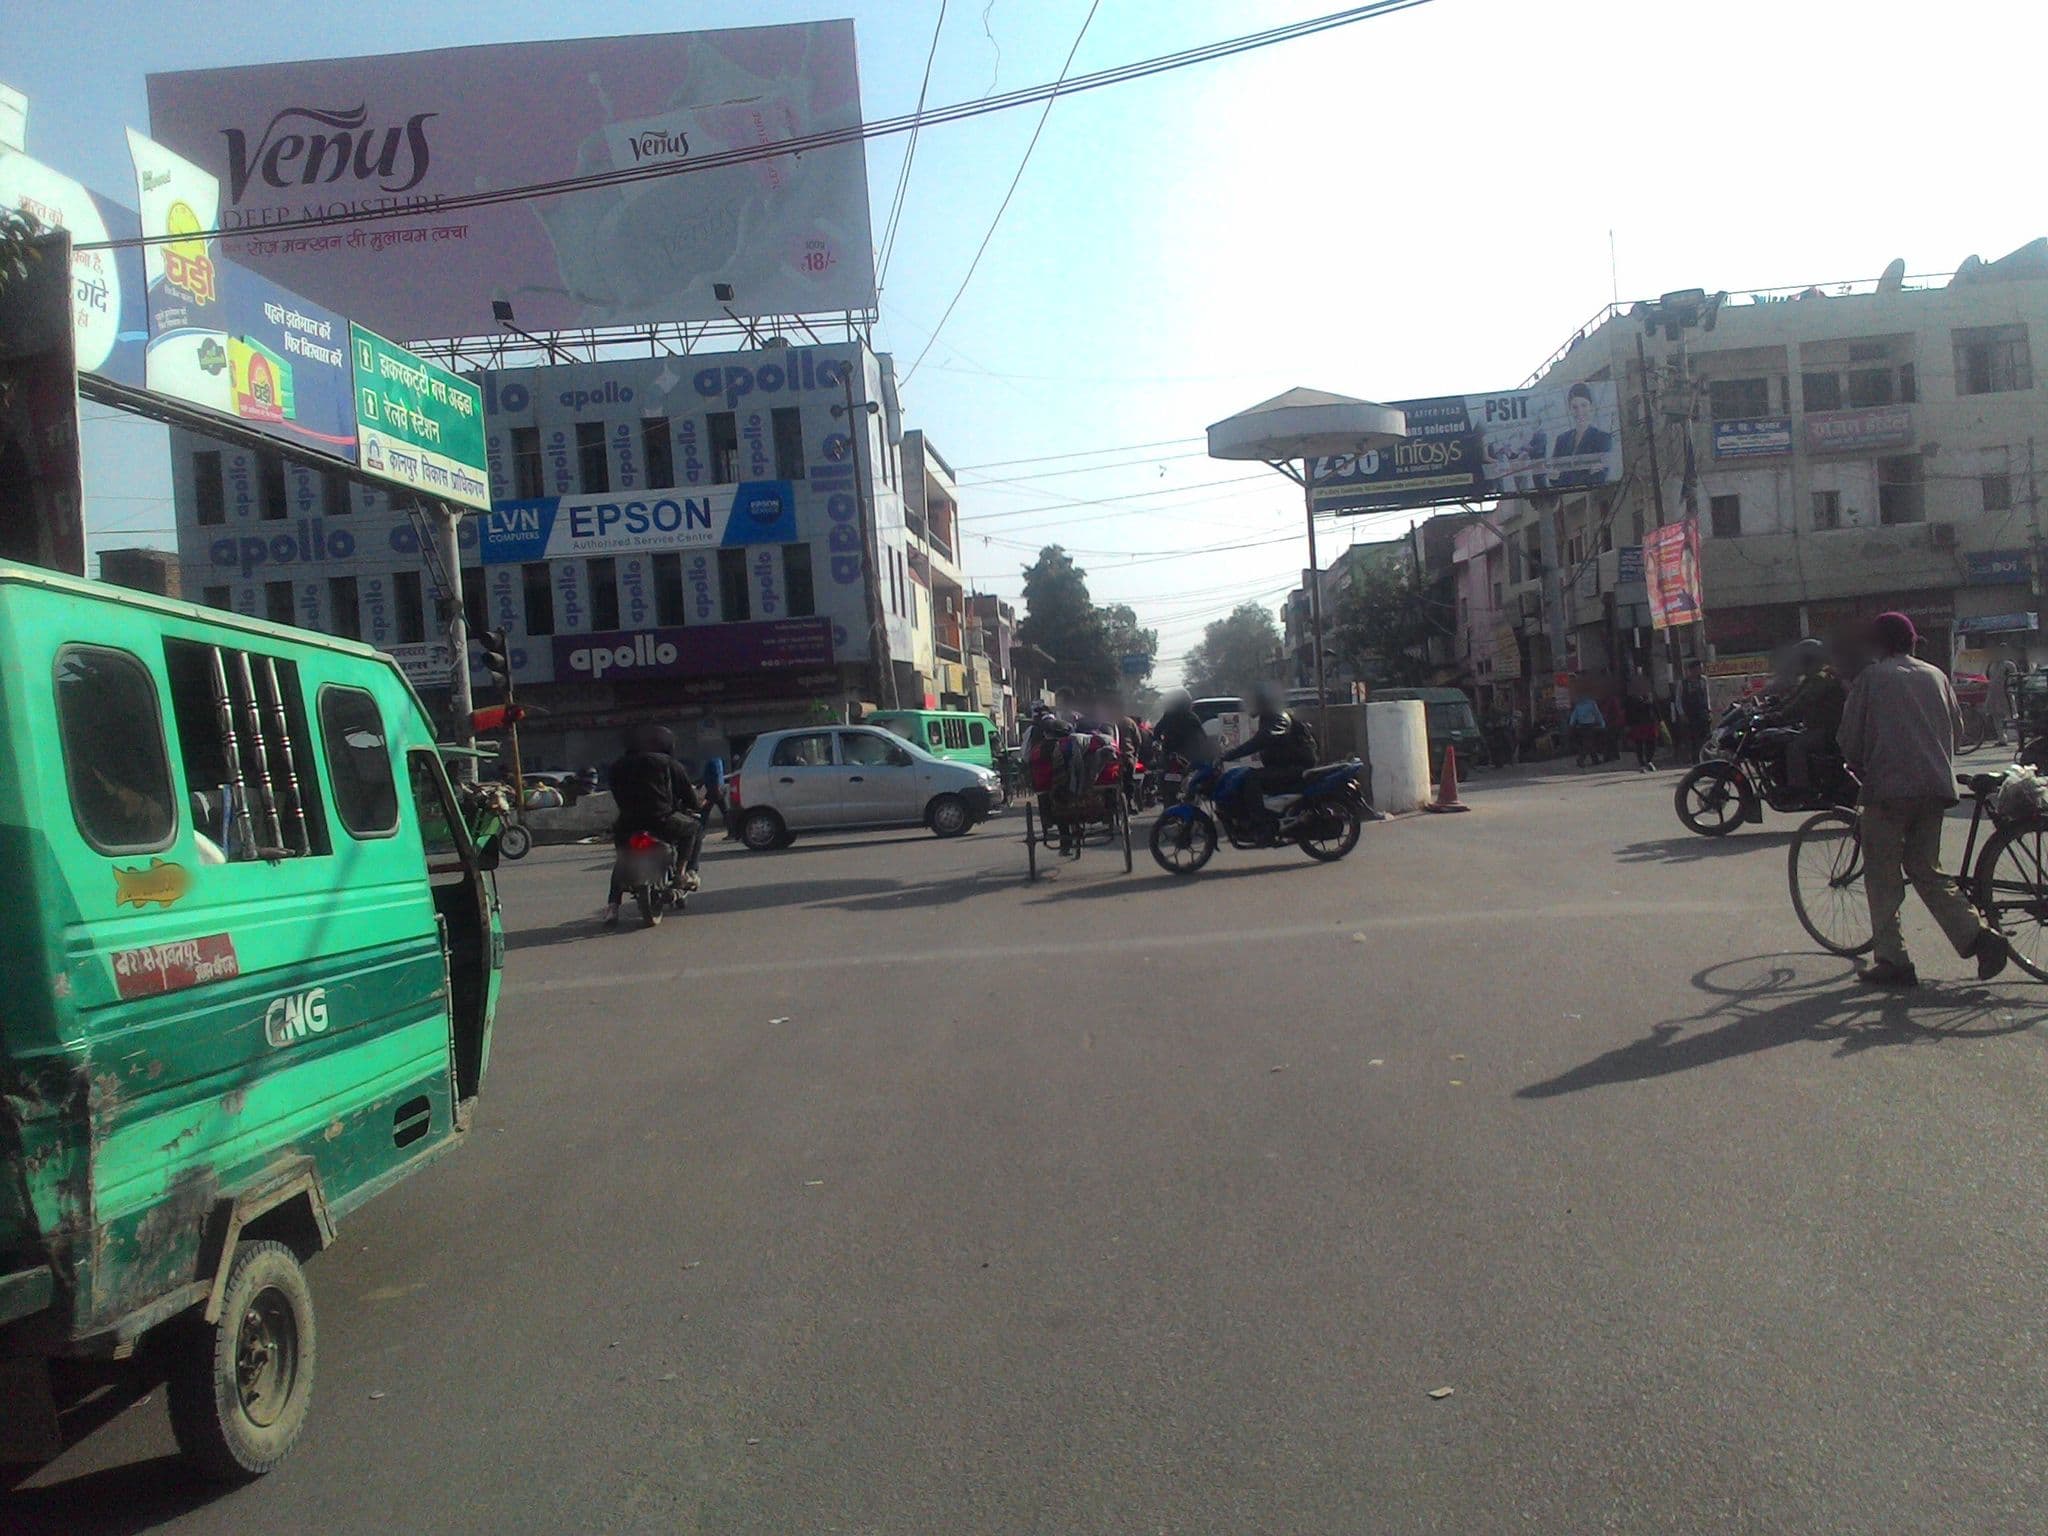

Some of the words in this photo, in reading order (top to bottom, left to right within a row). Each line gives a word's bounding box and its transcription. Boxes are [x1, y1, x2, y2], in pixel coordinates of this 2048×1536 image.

[218, 102, 439, 205] Venus
[629, 131, 689, 161] Venus
[223, 207, 290, 229] DEEP
[303, 193, 452, 223] MOISTURE
[263, 302, 285, 326] पहले
[284, 331, 300, 353] फिर
[430, 378, 446, 405] बस
[559, 381, 634, 412] apollo
[693, 349, 848, 410] apollo
[383, 392, 409, 430] रेलवे
[409, 406, 441, 444] स्टेशन
[1485, 396, 1529, 422] PSIT
[388, 449, 418, 483] कानपुर
[421, 454, 449, 488] विकास
[548, 432, 573, 493] apollo
[612, 424, 639, 487] apollo
[678, 420, 703, 482] apollo
[744, 415, 769, 476] apollo
[291, 466, 316, 512] apol
[487, 508, 540, 533] LVN
[488, 531, 540, 543] COMPUTERS
[570, 497, 712, 538] EPSON
[209, 518, 356, 578] apollo
[573, 537, 631, 551] Authorized
[633, 534, 674, 545] Service
[677, 531, 713, 544] Centre
[558, 565, 584, 627] apollo
[622, 560, 648, 623] apollo
[687, 556, 714, 618] apollo
[754, 552, 780, 614] apollo
[570, 634, 678, 678] apollo
[265, 987, 329, 1048] CNG
